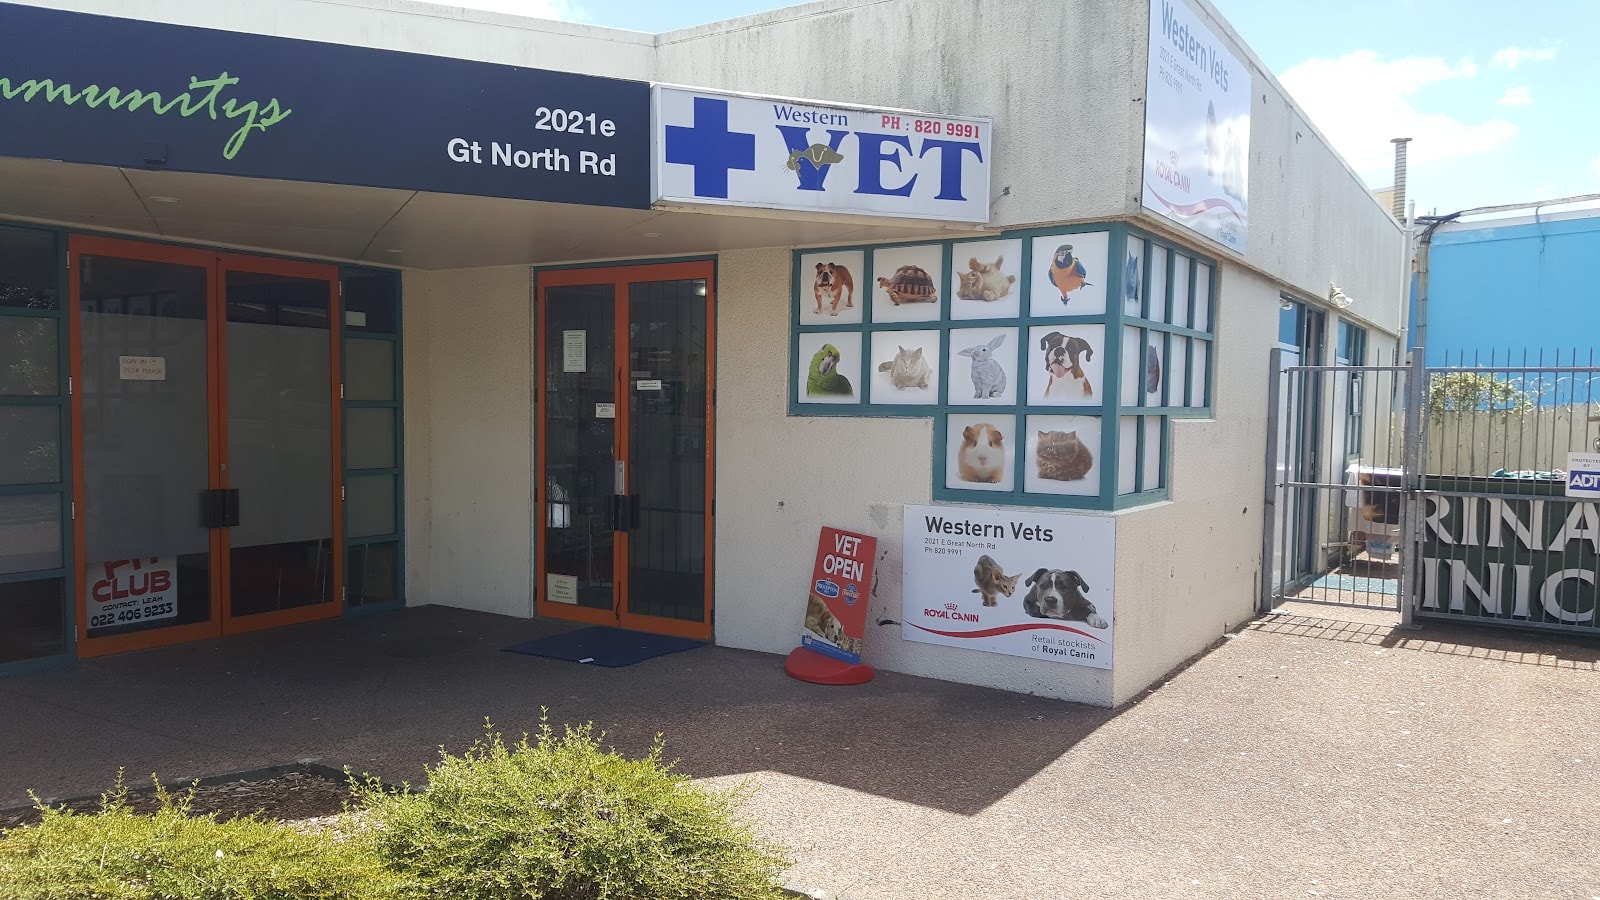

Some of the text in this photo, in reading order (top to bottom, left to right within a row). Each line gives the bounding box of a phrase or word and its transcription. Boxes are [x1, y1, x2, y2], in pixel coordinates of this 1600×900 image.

[1162, 0, 1229, 93] Western Vets
[535, 106, 616, 137] 2021e
[773, 104, 848, 126] Western
[881, 115, 901, 130] PH
[914, 120, 941, 135] 820
[946, 123, 980, 139] 9991
[447, 137, 616, 176] Gt North Rd
[775, 124, 984, 202] VET
[1570, 474, 1600, 488] ADT
[925, 515, 1054, 542] Western Vets
[834, 533, 862, 557] VET
[924, 537, 940, 545] 2021
[947, 539, 965, 548] Great
[966, 541, 985, 549] North
[934, 547, 946, 555] 820
[947, 548, 962, 556] 9991
[823, 554, 864, 582] OPEN
[92, 569, 171, 603] CLUB
[91, 602, 173, 627] 022 406 9233
[102, 596, 163, 611] CONTACT: LEAH
[924, 608, 979, 623] ROYAL CANIN
[1031, 634, 1096, 651] Retail stockists
[1031, 644, 1095, 660] of Royal Canin
